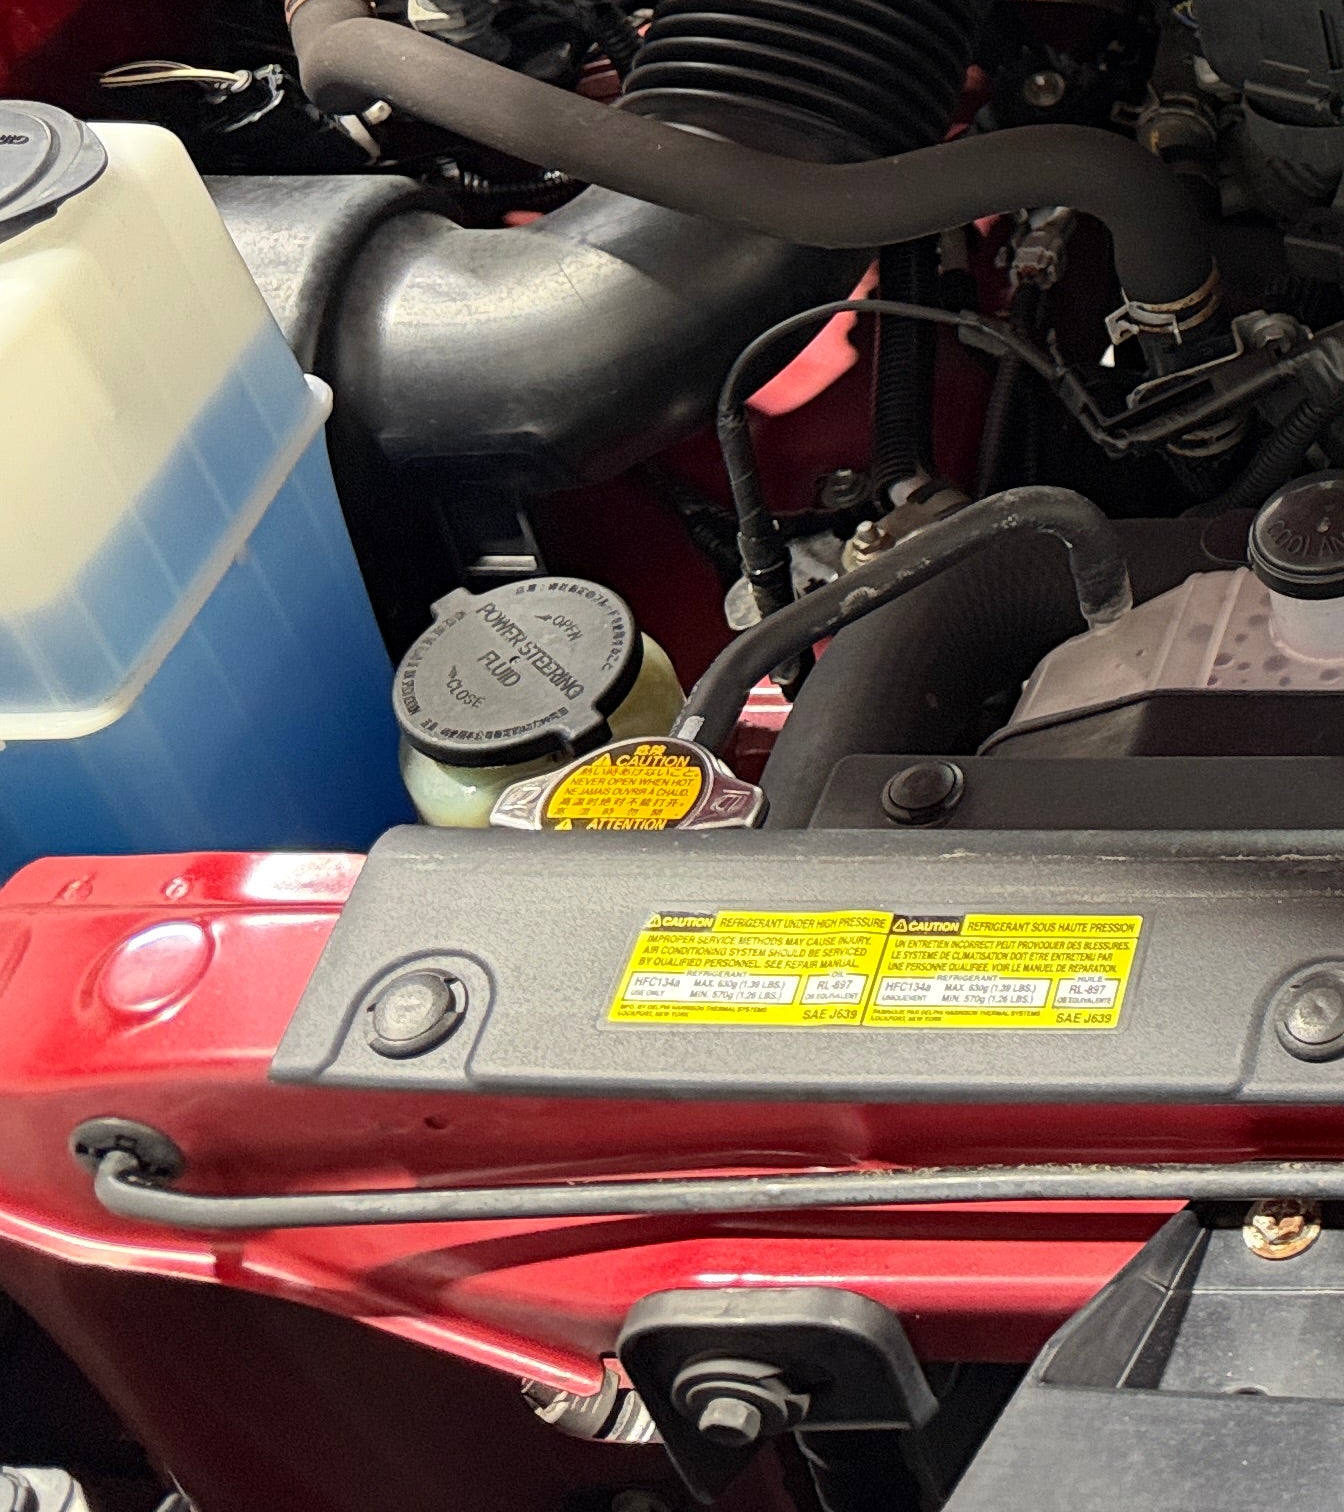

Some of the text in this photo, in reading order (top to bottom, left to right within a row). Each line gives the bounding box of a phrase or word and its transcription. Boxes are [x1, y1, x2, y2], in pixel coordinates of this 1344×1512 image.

[552, 615, 584, 642] OPEN
[476, 602, 527, 648] POWER
[518, 641, 586, 701] STEERING
[476, 649, 521, 688] FLUID
[446, 678, 486, 709] CLOSE
[616, 755, 691, 767] CAUTION
[570, 778, 606, 786] NEVER
[607, 778, 636, 786] OPEN
[639, 778, 669, 787] WHEN
[586, 819, 669, 831] ATTENTION
[662, 917, 887, 929] CAUTION REFRIGERANT UNDER HIGH PRESSURE
[909, 920, 960, 932] CAUTION
[1031, 922, 1057, 933] SOUS
[1059, 923, 1088, 933] HAUTE
[1089, 923, 1135, 933] PRESSION
[647, 935, 695, 944] IMPROPER
[697, 935, 736, 945] SERVICE
[785, 937, 804, 946] MAY
[806, 937, 836, 946] CAUSE
[642, 946, 659, 954] AIR
[729, 947, 766, 957] SYSTEM
[768, 948, 806, 957] SHOULD
[808, 948, 821, 957] BE
[823, 947, 868, 957] SERVICED
[638, 957, 653, 966] BY
[653, 958, 704, 967] QUALIFIED
[764, 959, 783, 969] SEE
[785, 959, 818, 969] REPAIR
[634, 977, 681, 987] HFC134a
[885, 982, 931, 992] HFC134a
[802, 1009, 857, 1020] SAE J639
[1056, 1013, 1112, 1024] SAE J639
